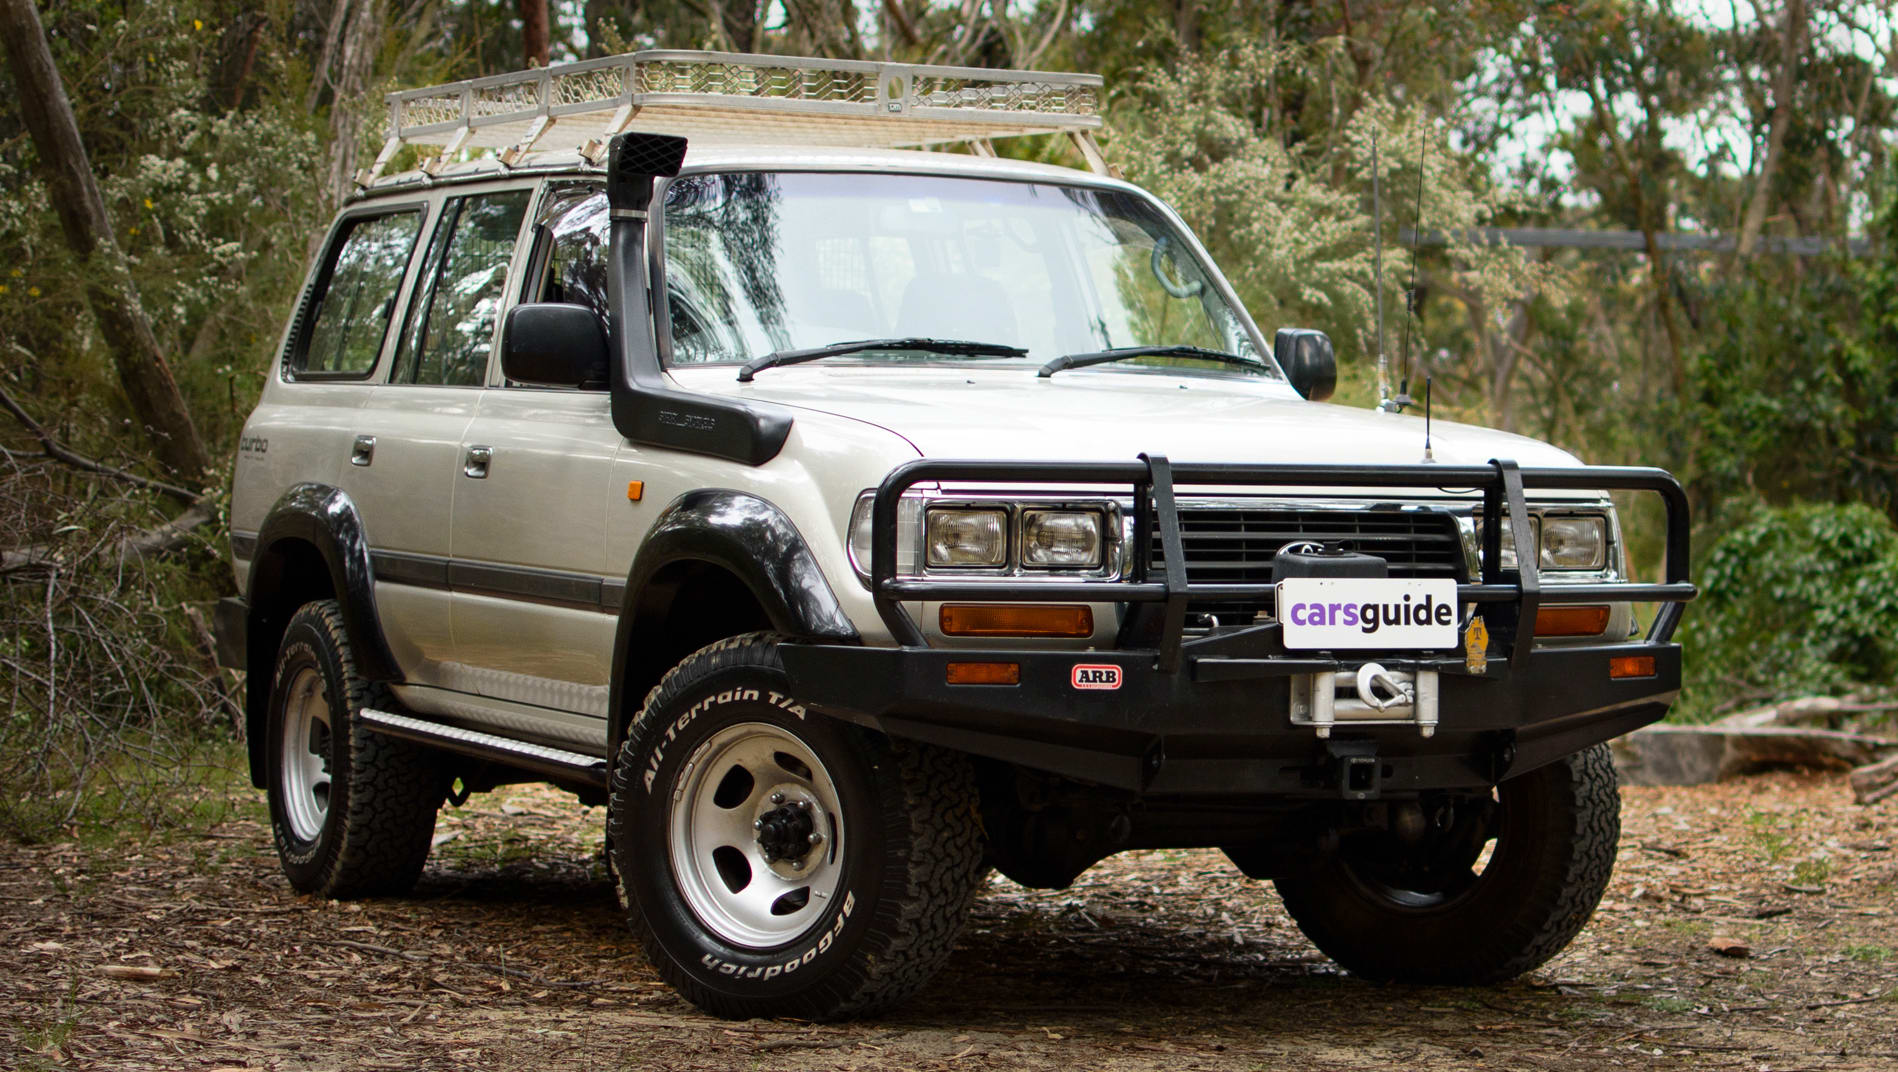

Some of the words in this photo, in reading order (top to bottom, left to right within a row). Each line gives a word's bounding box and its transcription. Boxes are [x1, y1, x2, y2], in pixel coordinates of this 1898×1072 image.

[240, 434, 269, 453] turbo
[1290, 593, 1453, 634] carsguide
[1078, 669, 1117, 683] ARB
[643, 686, 760, 796] All-Terrain
[768, 690, 807, 721] T/A
[701, 890, 856, 982] BFGoodrich
